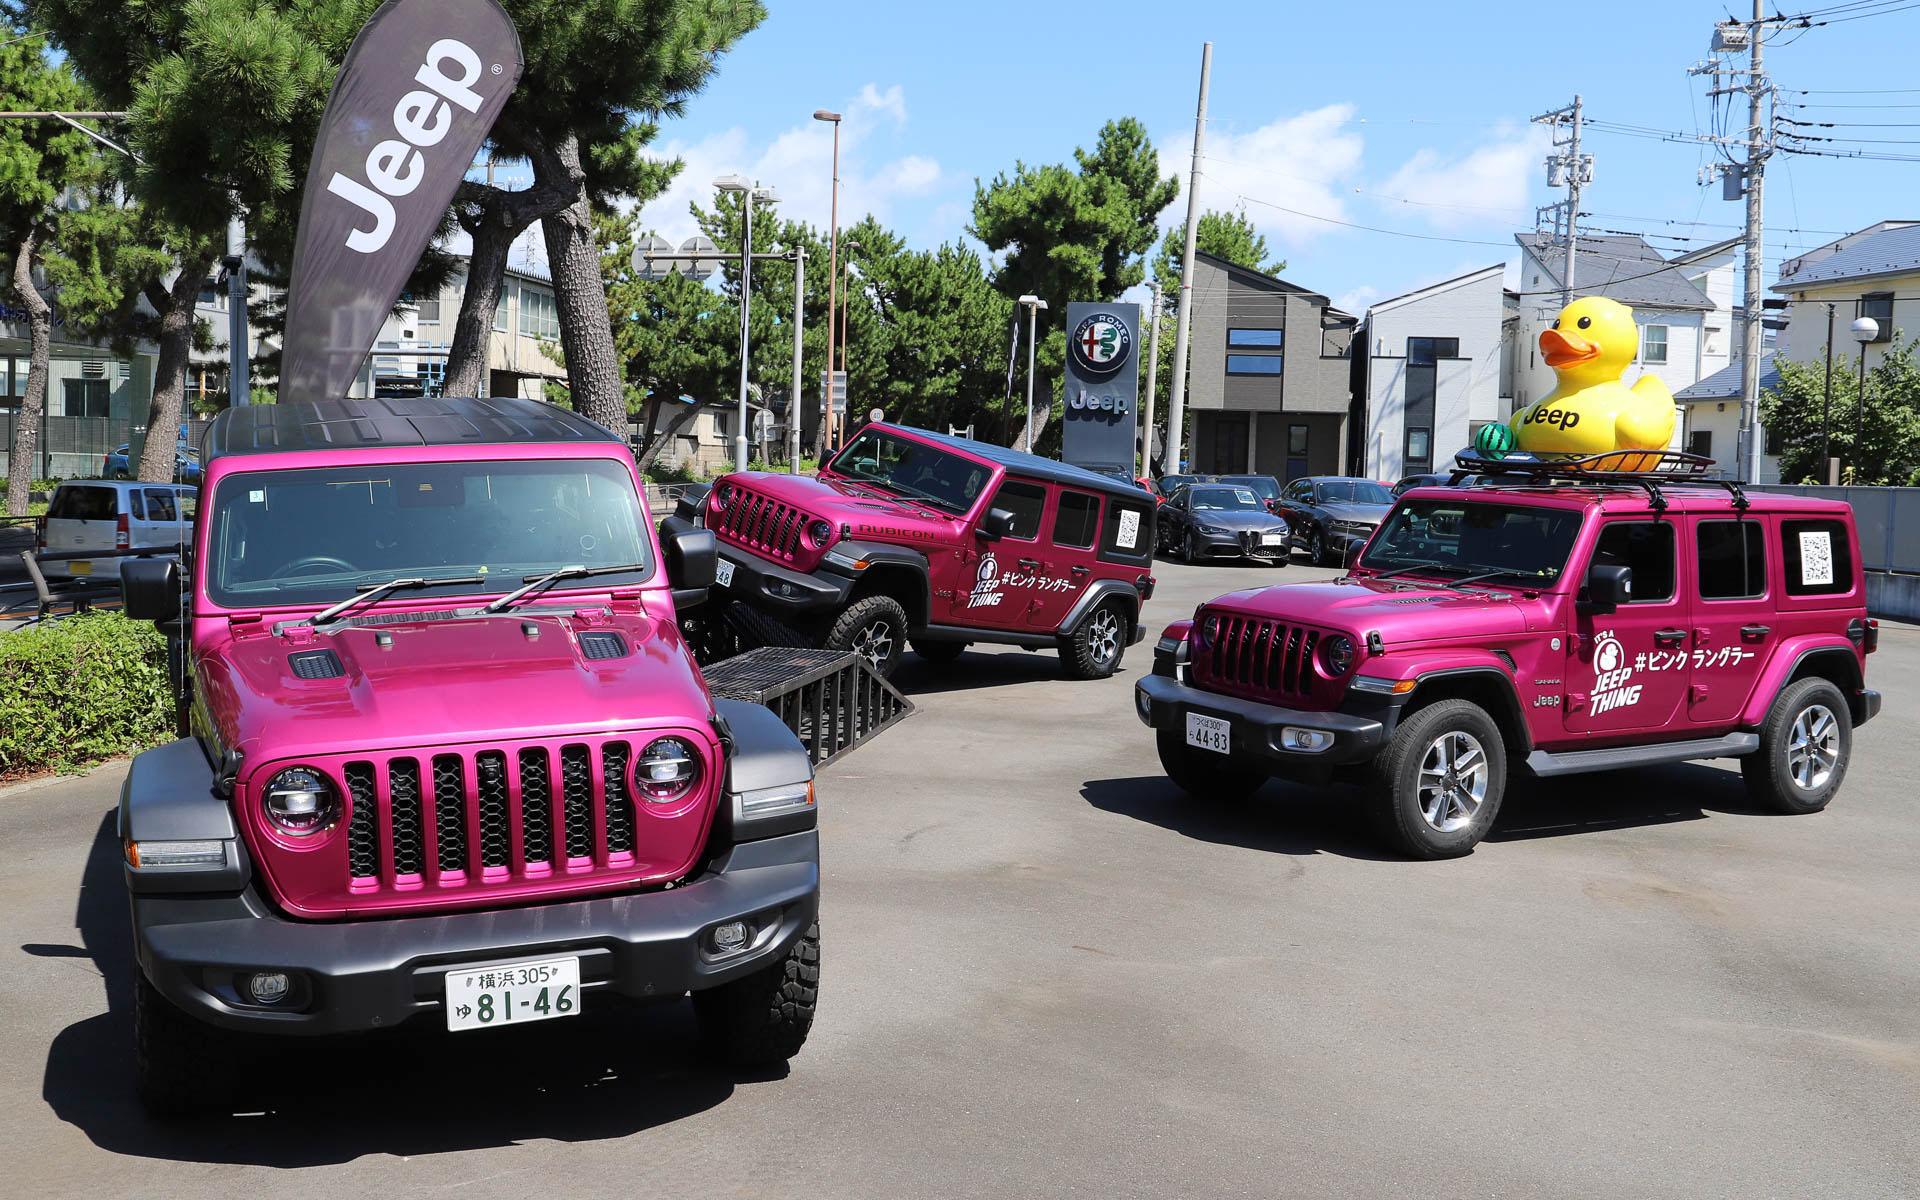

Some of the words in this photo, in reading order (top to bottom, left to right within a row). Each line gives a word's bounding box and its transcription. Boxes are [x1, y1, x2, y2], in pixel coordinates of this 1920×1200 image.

[327, 38, 485, 254] Jeep
[1075, 318, 1095, 342] ALFA
[1099, 315, 1129, 344] ROMEO
[1071, 390, 1129, 414] Jeep
[1523, 404, 1580, 431] Jeep
[859, 524, 935, 539] RUBICON
[970, 579, 1001, 595] JEEP
[967, 592, 1004, 609] THING
[1593, 630, 1608, 644] IT'S
[1608, 629, 1615, 638] A
[1590, 667, 1633, 696] JEEP
[1533, 695, 1560, 708] Jeep
[1589, 684, 1643, 717] THING
[1195, 728, 1227, 751] 44-83
[455, 1003, 472, 1020] ゆ
[477, 984, 573, 1023] 81-46
